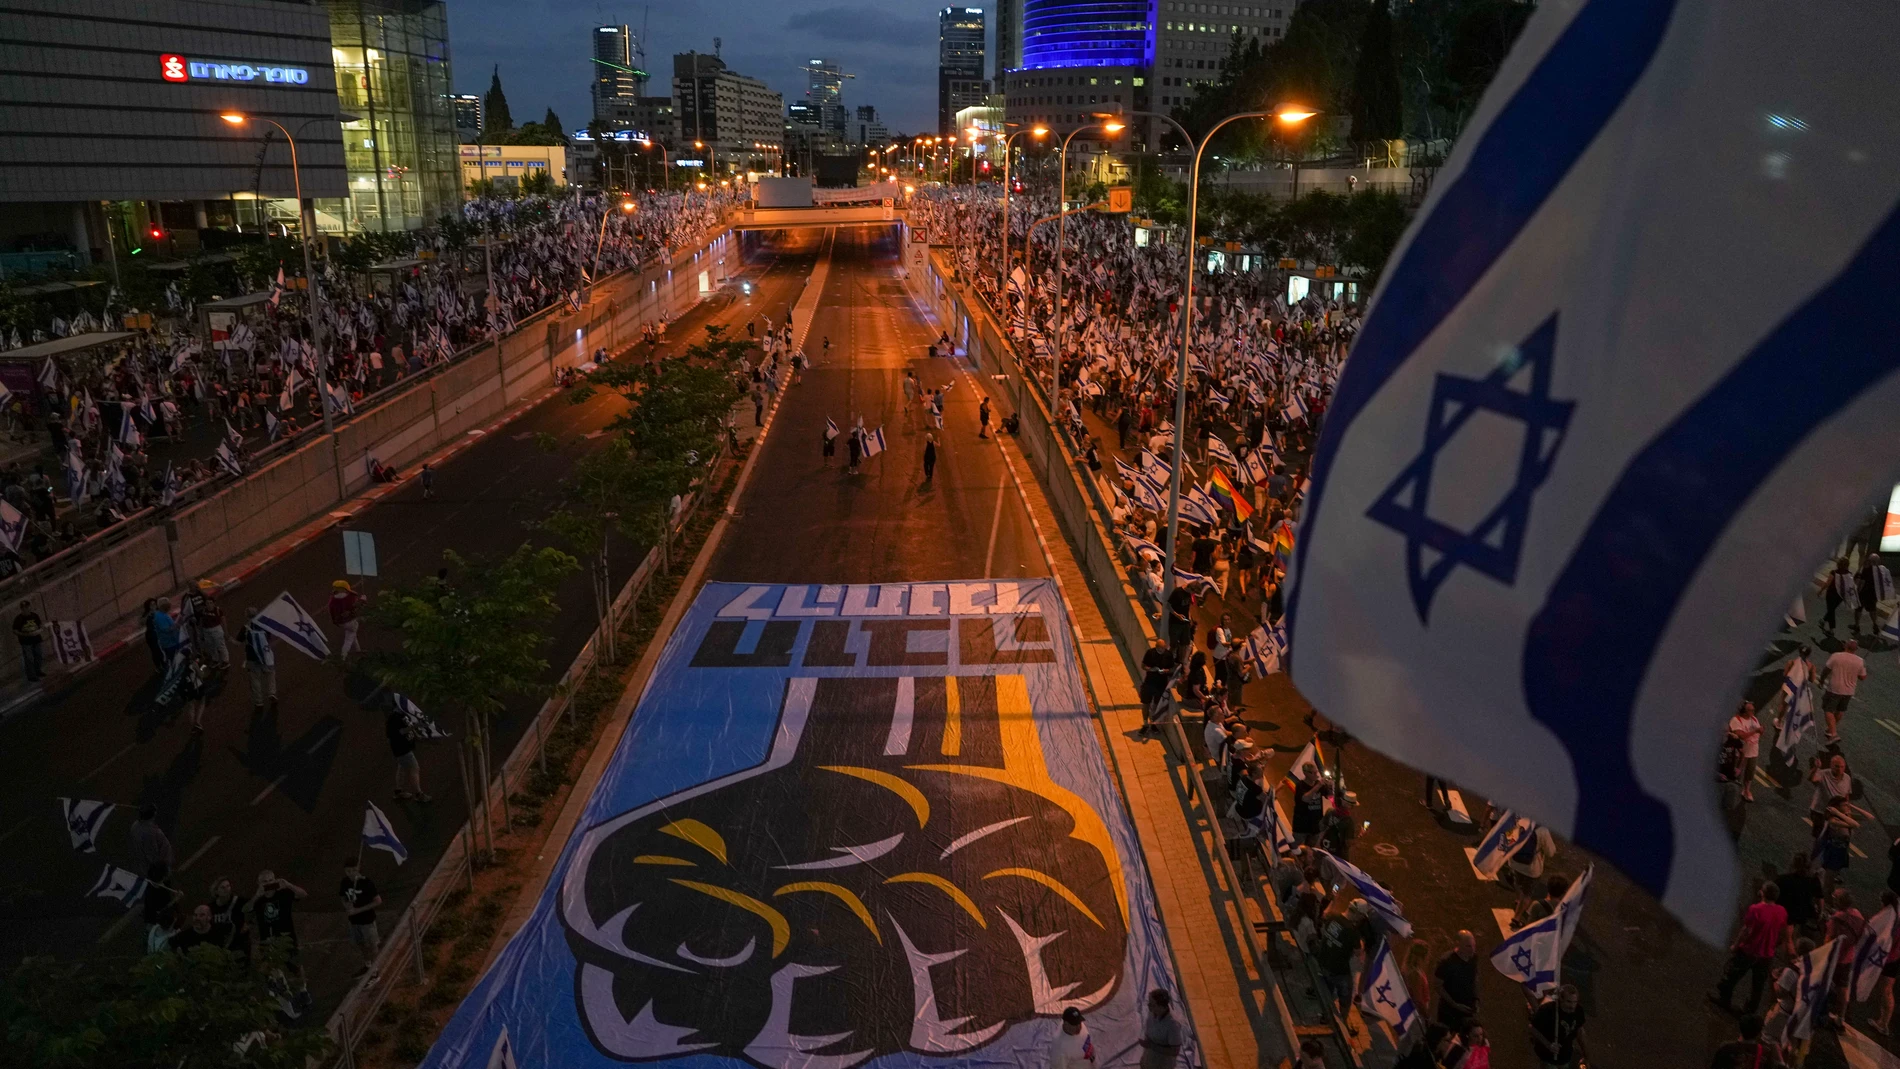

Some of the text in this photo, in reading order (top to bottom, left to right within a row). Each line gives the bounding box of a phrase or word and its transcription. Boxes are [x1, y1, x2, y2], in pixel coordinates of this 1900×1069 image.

[190, 62, 308, 84] סופר-פארם
[717, 583, 1040, 618] להתנגד
[689, 619, 1057, 667] חובה
